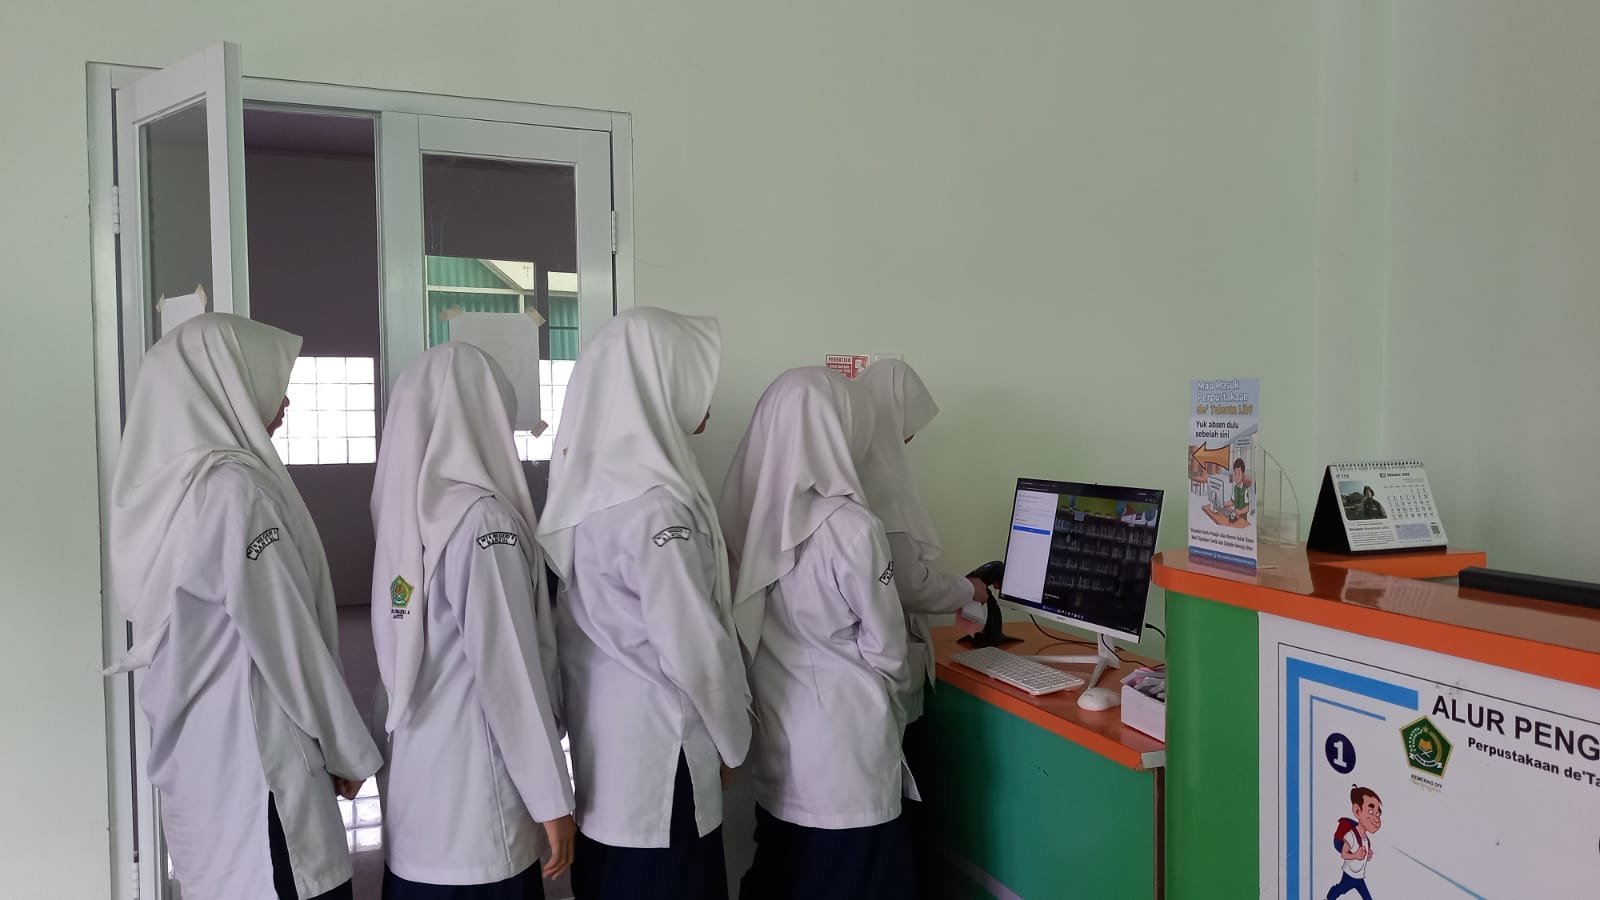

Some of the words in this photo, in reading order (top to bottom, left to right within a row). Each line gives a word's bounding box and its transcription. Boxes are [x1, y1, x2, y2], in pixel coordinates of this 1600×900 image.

[1197, 381, 1214, 390] Mau
[1216, 379, 1240, 390] Masuk
[1197, 391, 1249, 403] Perpustakaan
[1209, 421, 1226, 429] absen
[1227, 421, 1239, 429] dulu
[1195, 430, 1219, 438] sebelah
[1220, 430, 1230, 439] sini
[1432, 695, 1505, 736] ALUR
[1515, 715, 1600, 761] PENG
[1333, 740, 1347, 768] 1
[1468, 736, 1560, 775] Perpustakaan
